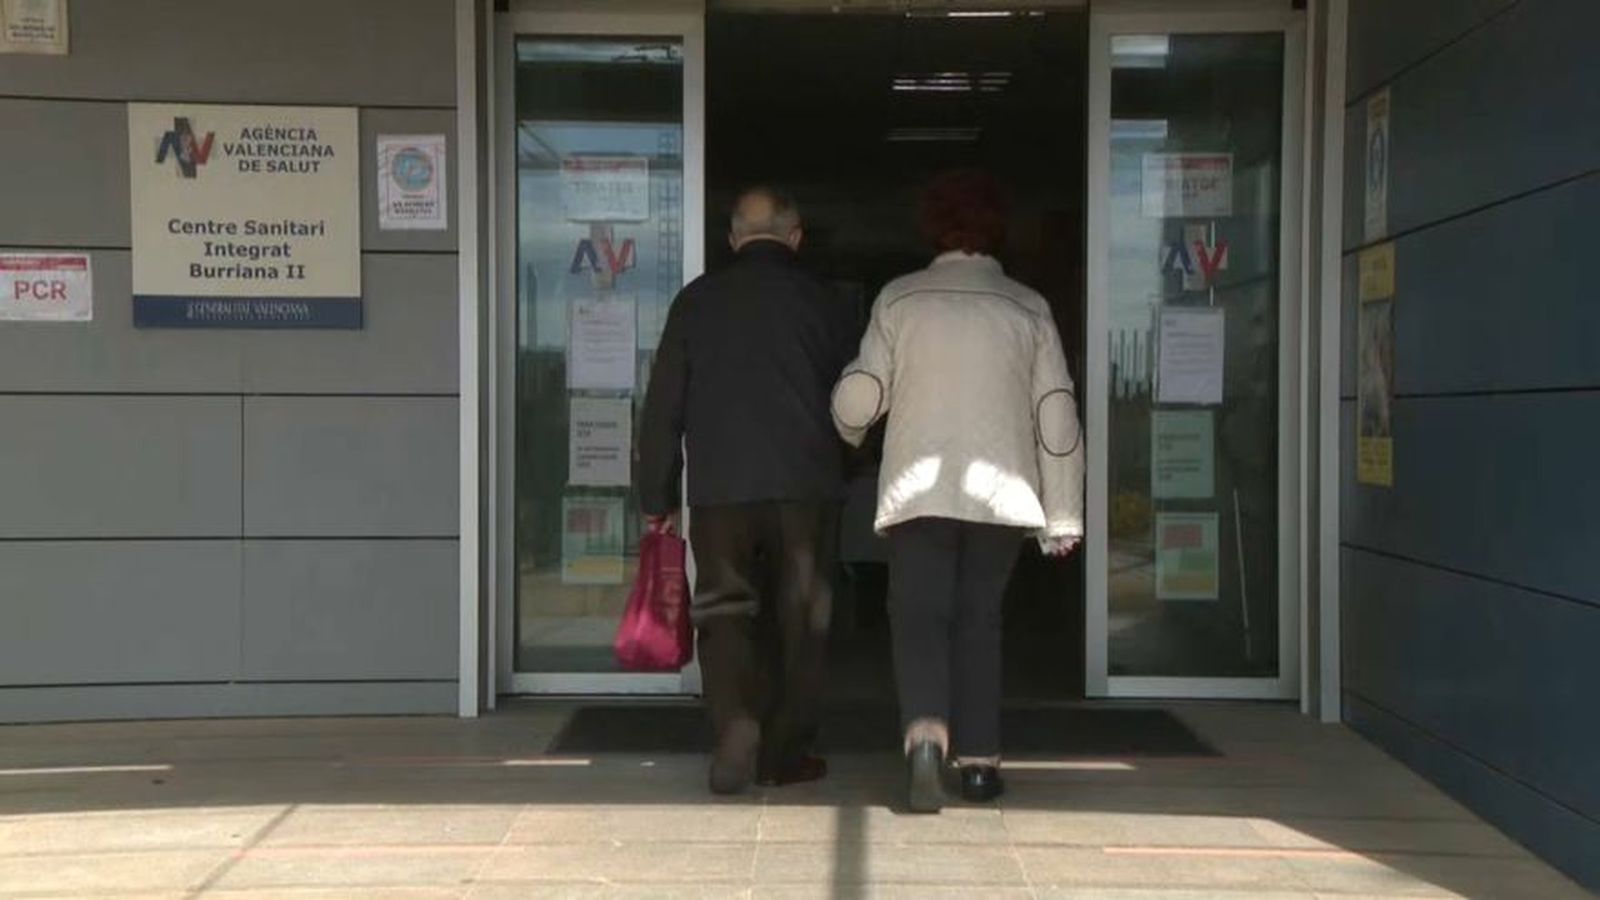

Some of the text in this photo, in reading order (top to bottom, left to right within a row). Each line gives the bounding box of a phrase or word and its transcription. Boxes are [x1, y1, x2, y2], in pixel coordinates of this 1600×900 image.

[223, 143, 335, 158] VALENCIANA
[238, 160, 321, 174] DE SALUT
[167, 218, 325, 236] Centre Sanitari
[203, 241, 292, 260] Integrat
[189, 263, 306, 280] Burriana II
[14, 280, 67, 300] PCR
